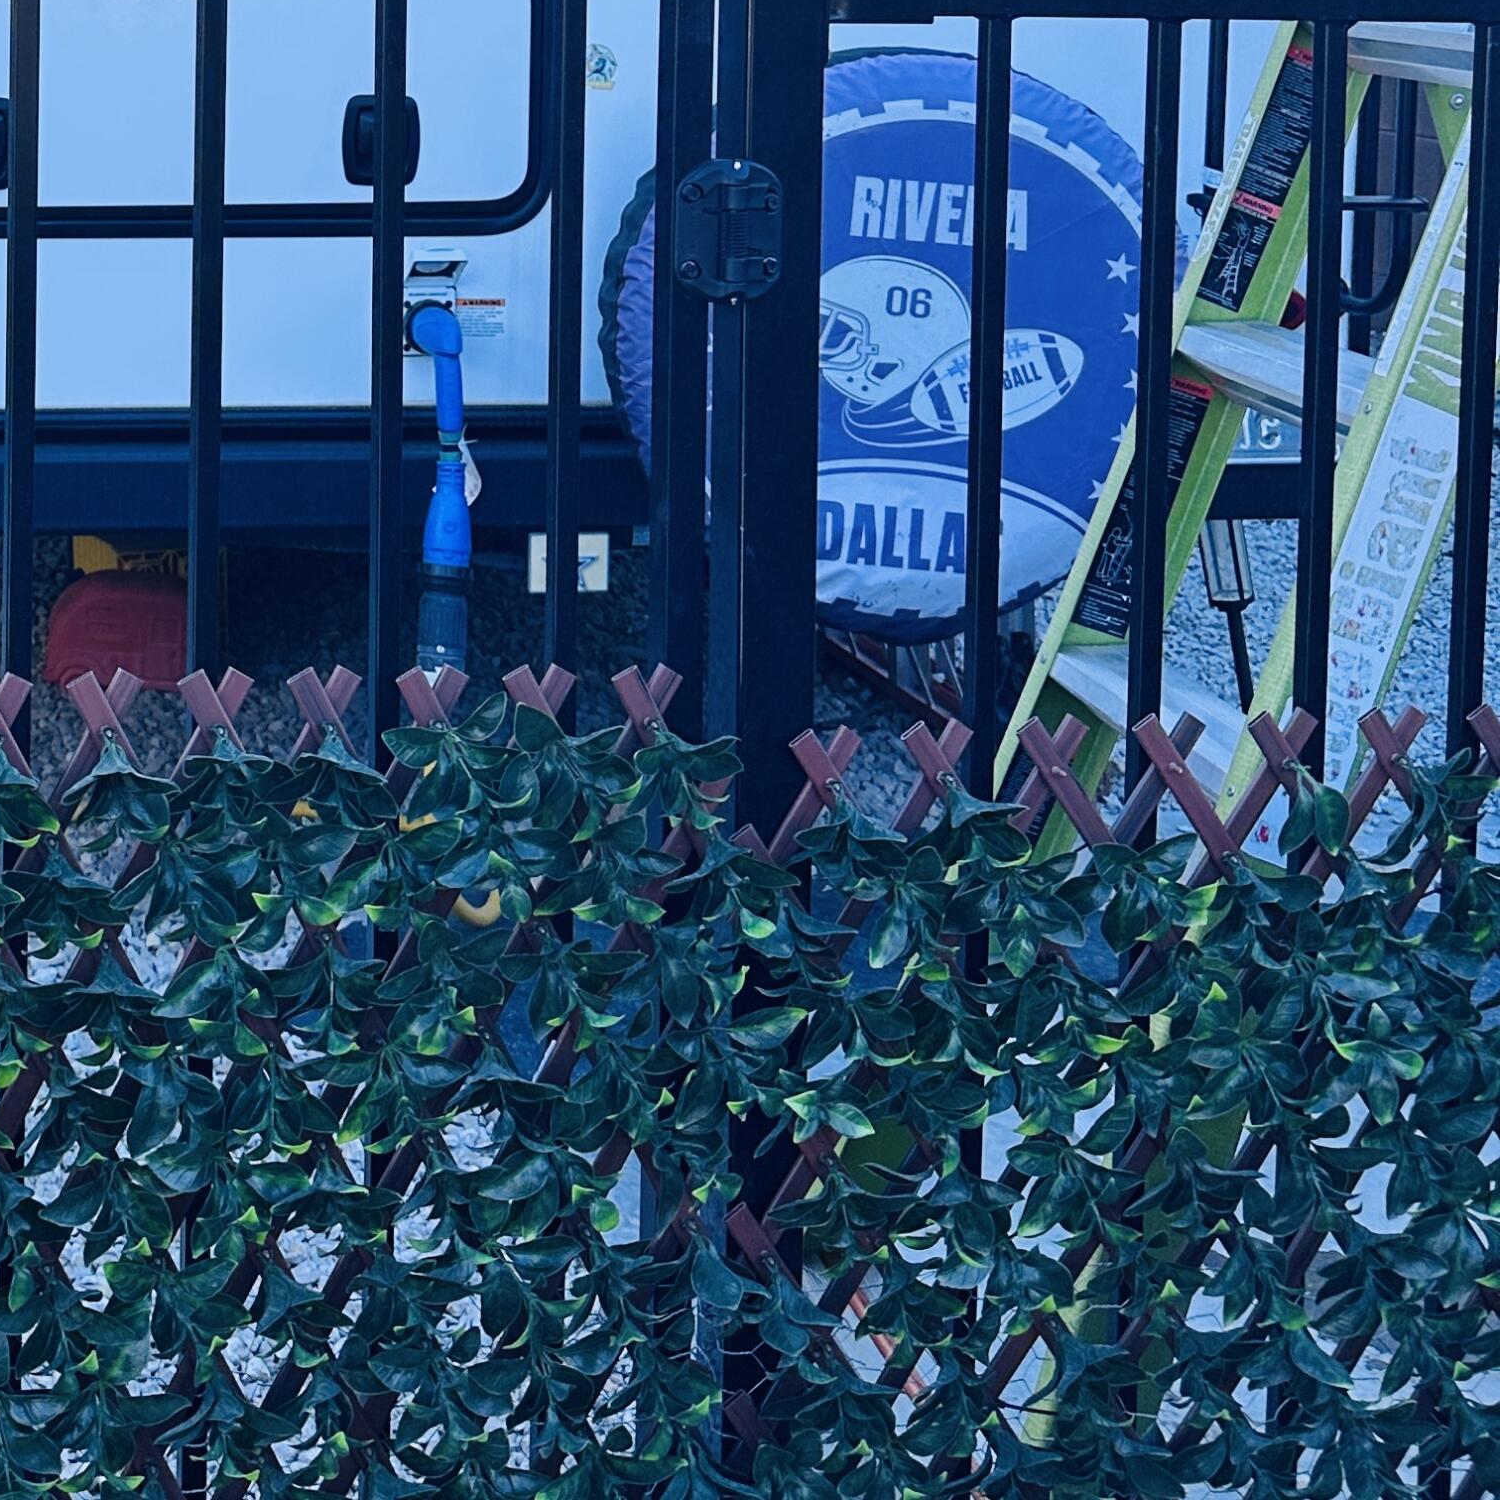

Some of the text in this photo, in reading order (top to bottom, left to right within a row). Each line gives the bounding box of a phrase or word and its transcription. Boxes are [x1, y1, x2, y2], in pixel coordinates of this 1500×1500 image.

[886, 285, 933, 319] 06
[958, 361, 1043, 404] FBALL
[816, 499, 1004, 574] DALLA
